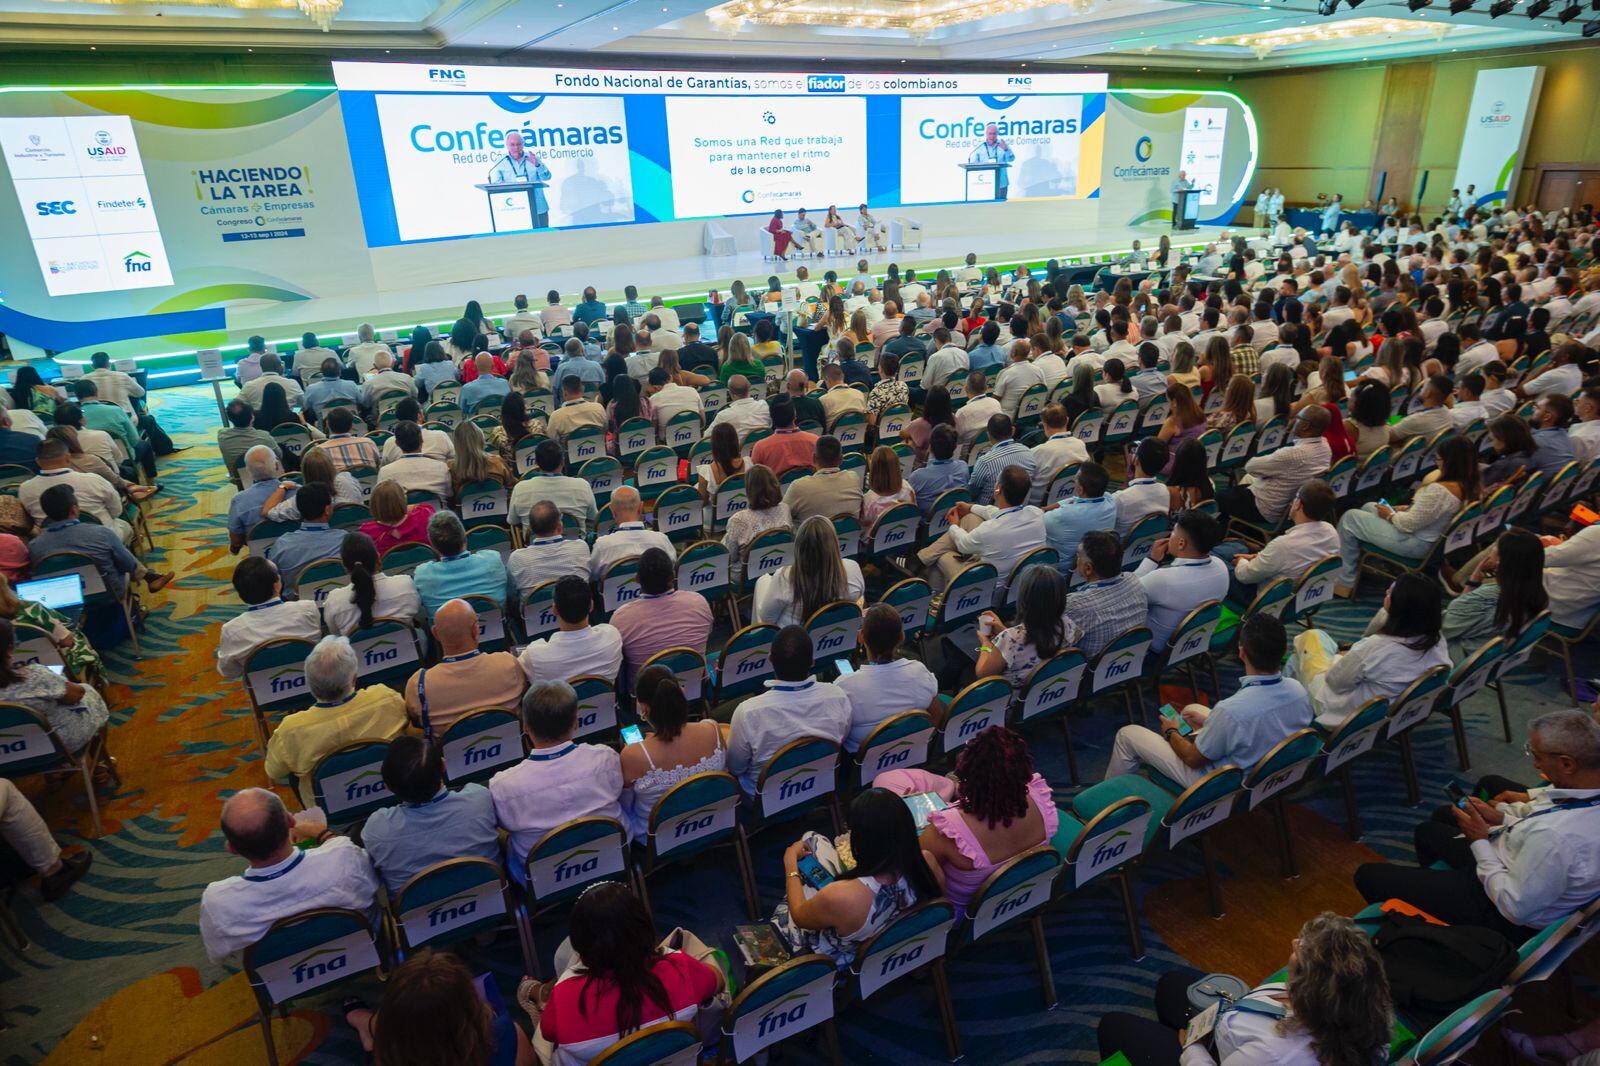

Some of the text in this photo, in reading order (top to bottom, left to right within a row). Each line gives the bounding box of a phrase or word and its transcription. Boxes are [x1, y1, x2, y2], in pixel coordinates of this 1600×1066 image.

[429, 69, 466, 79] FNG
[555, 74, 599, 87] Fondo
[604, 75, 662, 88] Nacional
[667, 76, 683, 88] de
[754, 80, 792, 89] somos
[808, 76, 845, 90] fiador
[848, 79, 862, 89] de
[864, 79, 881, 90] los
[883, 78, 958, 90] colombianos
[410, 120, 623, 153] Confeámaras
[694, 135, 843, 148] Somos una Red que trabaja
[1016, 137, 1051, 146] Comercio
[87, 146, 126, 156] USAID
[945, 140, 961, 149] Red
[962, 140, 972, 148] de
[453, 153, 473, 164] Red
[475, 153, 488, 164] de
[549, 148, 594, 159] Comercio
[709, 149, 831, 164] para mantener el ritmo
[730, 165, 744, 176] de
[747, 165, 756, 174] la
[1114, 165, 1170, 178] Confecámaras
[210, 186, 236, 200] LA
[36, 200, 77, 216] SEC
[98, 200, 136, 209] Findeter
[264, 201, 314, 212] Empresas
[216, 219, 253, 227] Congreso
[125, 258, 152, 273] fna
[904, 370, 917, 378] fna
[705, 399, 719, 408] fna
[1026, 403, 1038, 411] fna
[887, 422, 902, 432] fna
[675, 431, 691, 441] fna
[840, 432, 856, 441] fna
[1079, 430, 1092, 439] fna
[628, 437, 646, 448] fna
[577, 445, 596, 456] fna
[647, 468, 667, 479] fna
[591, 479, 610, 490] fna
[1056, 488, 1074, 498] fna
[472, 500, 495, 512] fna
[726, 500, 746, 512] fna
[668, 512, 690, 526] fna
[884, 531, 906, 544] fna
[760, 556, 782, 570] fna
[690, 571, 715, 586] fna
[1304, 585, 1324, 601] fna
[956, 595, 980, 610] fna
[540, 612, 556, 626] fn
[816, 634, 844, 651] fna
[1181, 637, 1202, 652] fna
[364, 648, 398, 666] fna
[736, 658, 766, 675] fna
[1105, 660, 1131, 680] fna
[271, 676, 307, 694] fna
[1037, 685, 1066, 706] fna
[959, 716, 989, 738] fna
[0, 740, 26, 754] na
[463, 744, 502, 766] fna
[877, 748, 911, 770] fna
[1262, 769, 1293, 792] fna
[345, 783, 388, 801] fna
[779, 776, 816, 800] fna
[1183, 804, 1216, 831] fna
[674, 814, 714, 838] fna
[1091, 840, 1128, 868] fna
[554, 856, 598, 883] fna
[992, 890, 1032, 920] fna
[428, 900, 477, 928] fna
[880, 944, 925, 977] fna
[292, 954, 347, 984] fna
[757, 1002, 808, 1038] fna
